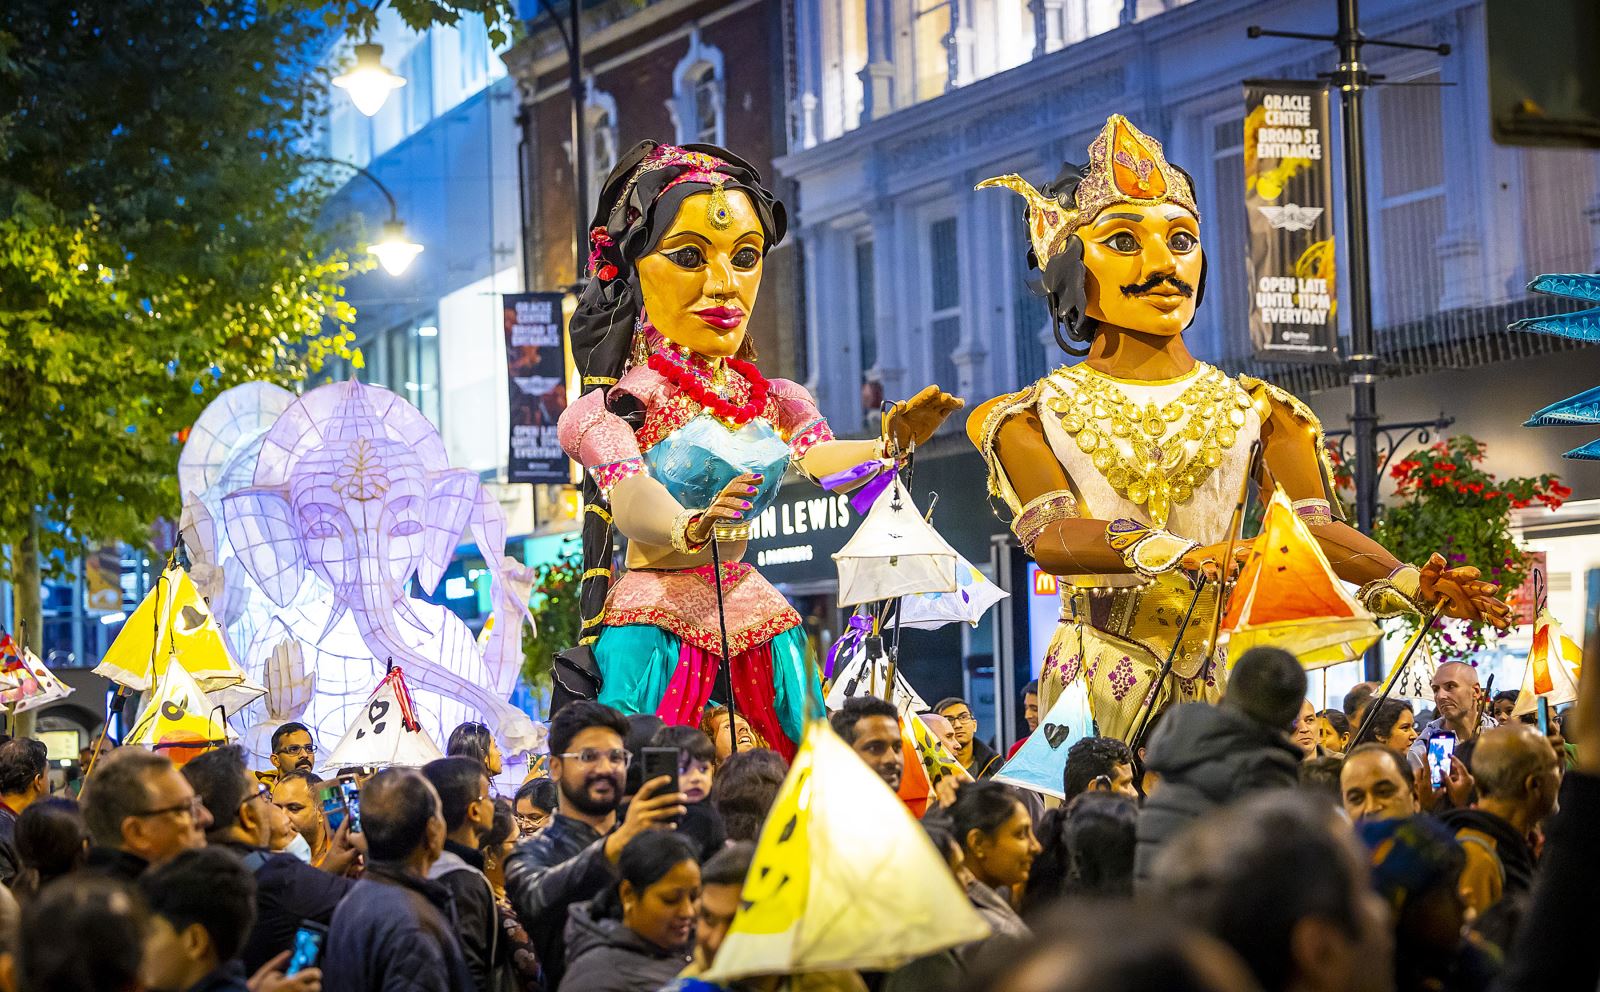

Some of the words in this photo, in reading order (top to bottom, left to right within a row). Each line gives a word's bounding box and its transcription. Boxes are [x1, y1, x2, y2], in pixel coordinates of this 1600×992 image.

[1263, 95, 1311, 111] ORACLE
[1265, 111, 1311, 126] CENTRE
[1258, 128, 1302, 144] BROAD
[1304, 129, 1319, 144] ST
[1257, 143, 1321, 160] ENTRANCE
[1259, 277, 1296, 293] OPEN
[1298, 278, 1327, 294] LATE
[1256, 292, 1294, 308] UNTIL
[1298, 294, 1330, 310] 11PM
[1262, 308, 1327, 325] EVERYDAY
[782, 494, 850, 536] LEWIS
